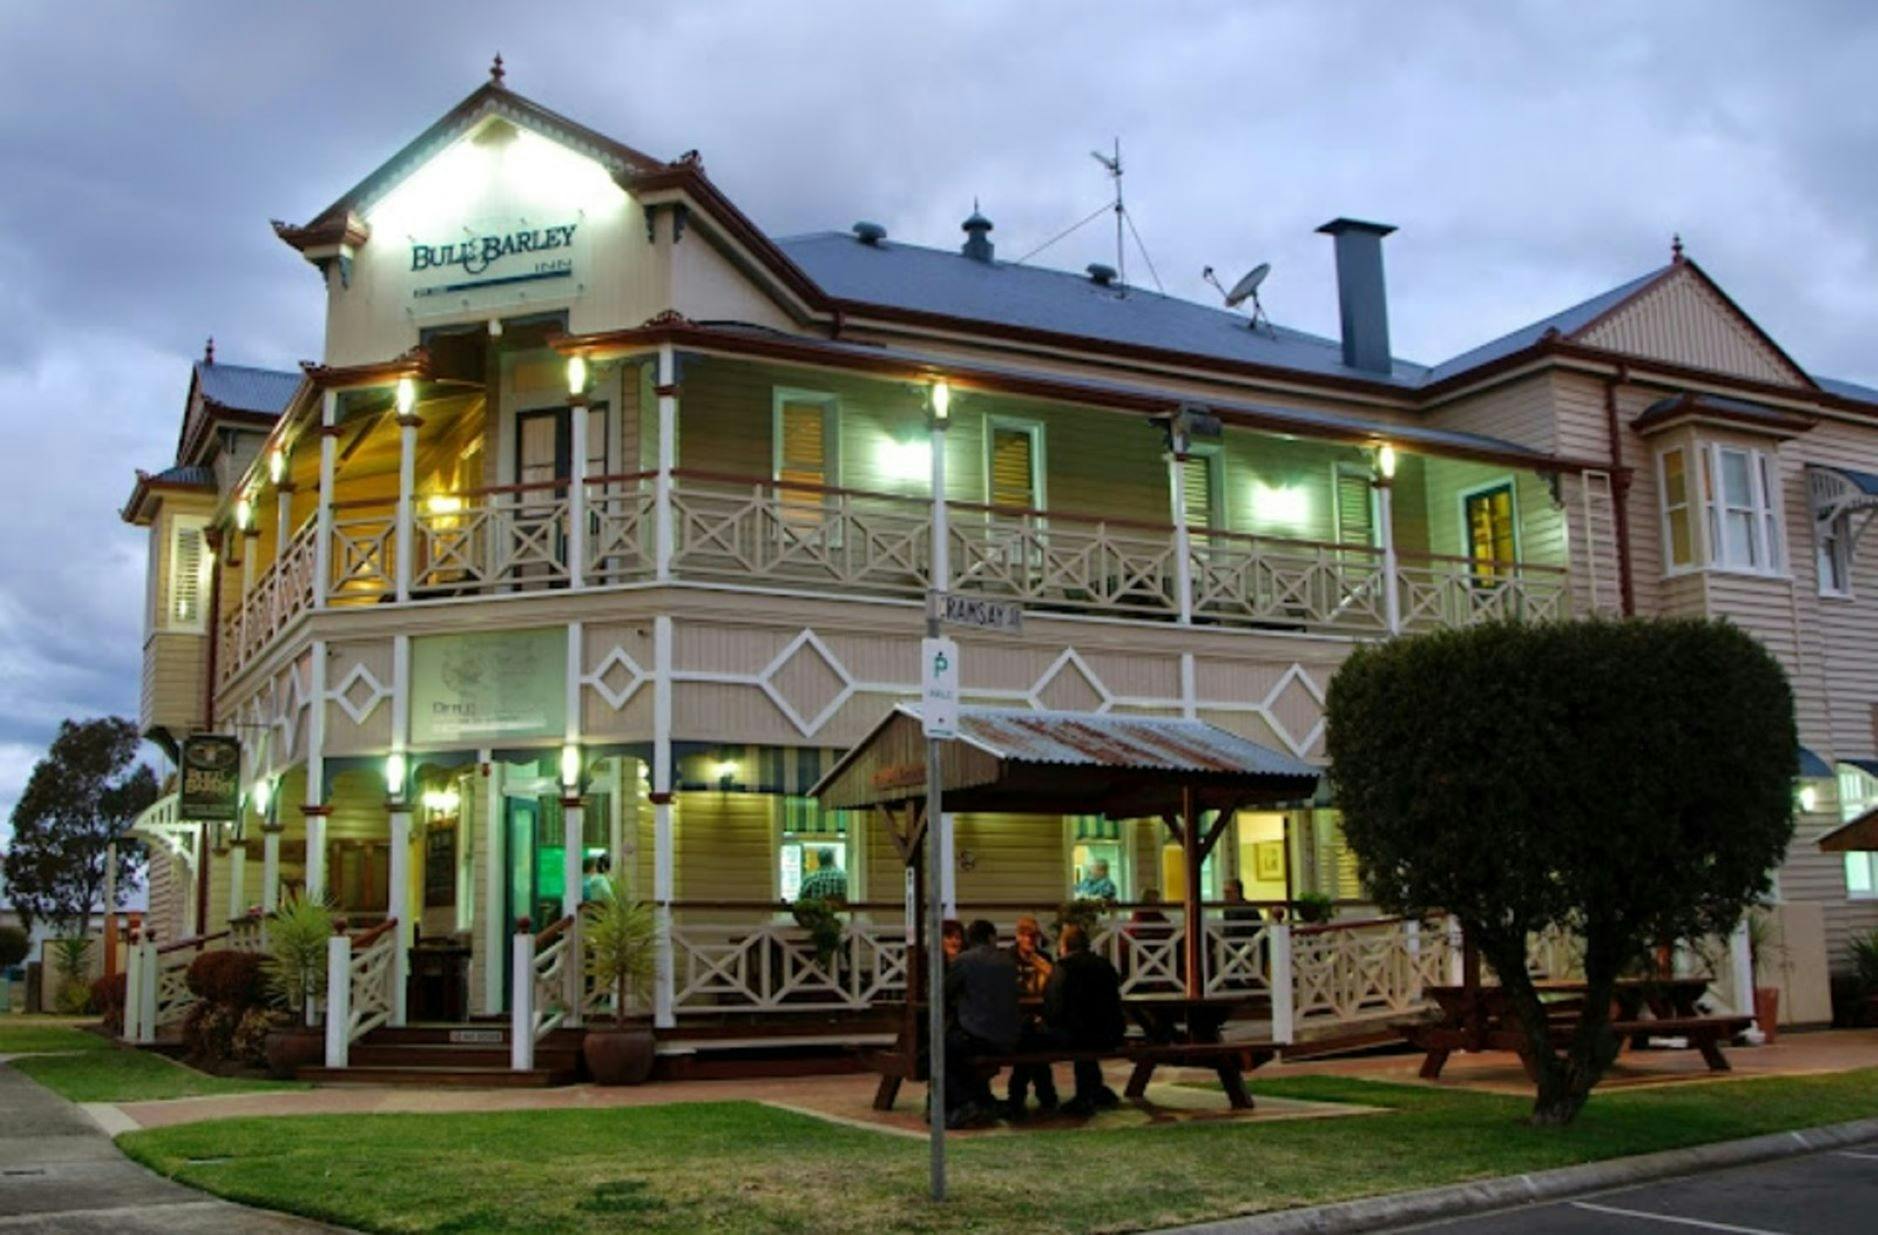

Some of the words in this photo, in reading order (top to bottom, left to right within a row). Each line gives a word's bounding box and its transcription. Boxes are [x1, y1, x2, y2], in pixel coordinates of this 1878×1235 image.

[481, 223, 578, 263] BARLEY
[946, 595, 1004, 627] RAMSAY
[933, 655, 949, 678] P
